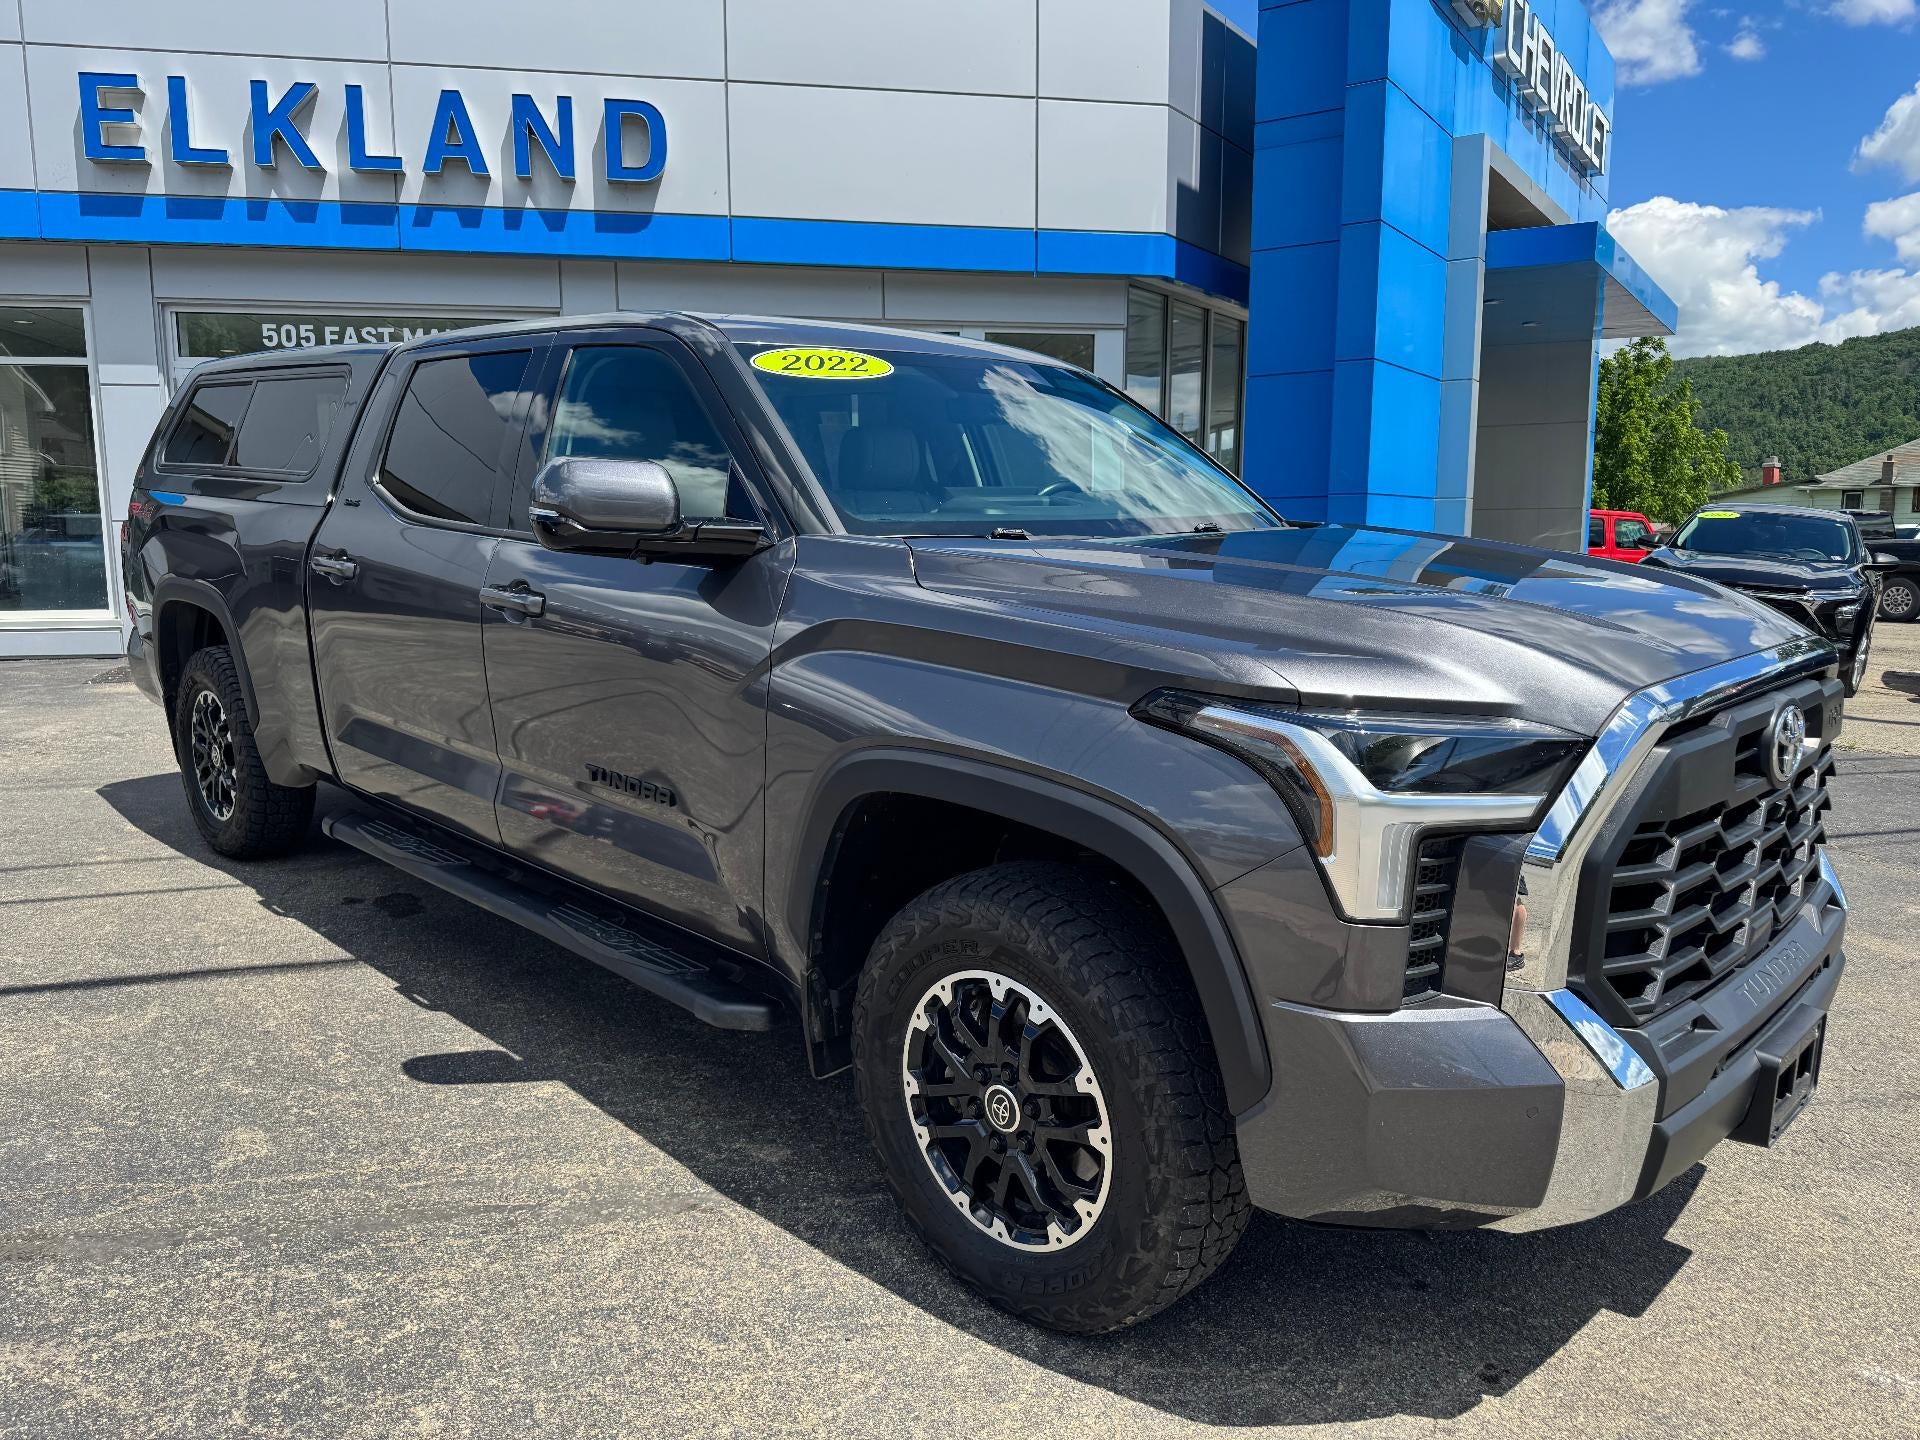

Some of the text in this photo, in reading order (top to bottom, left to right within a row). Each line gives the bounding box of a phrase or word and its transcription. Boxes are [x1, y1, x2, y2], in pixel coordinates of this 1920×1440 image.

[1496, 0, 1611, 176] CHEVROLET
[78, 71, 669, 182] ELKLAND
[262, 323, 316, 347] 505
[782, 354, 869, 373] 2022
[584, 763, 677, 807] TUNDRA
